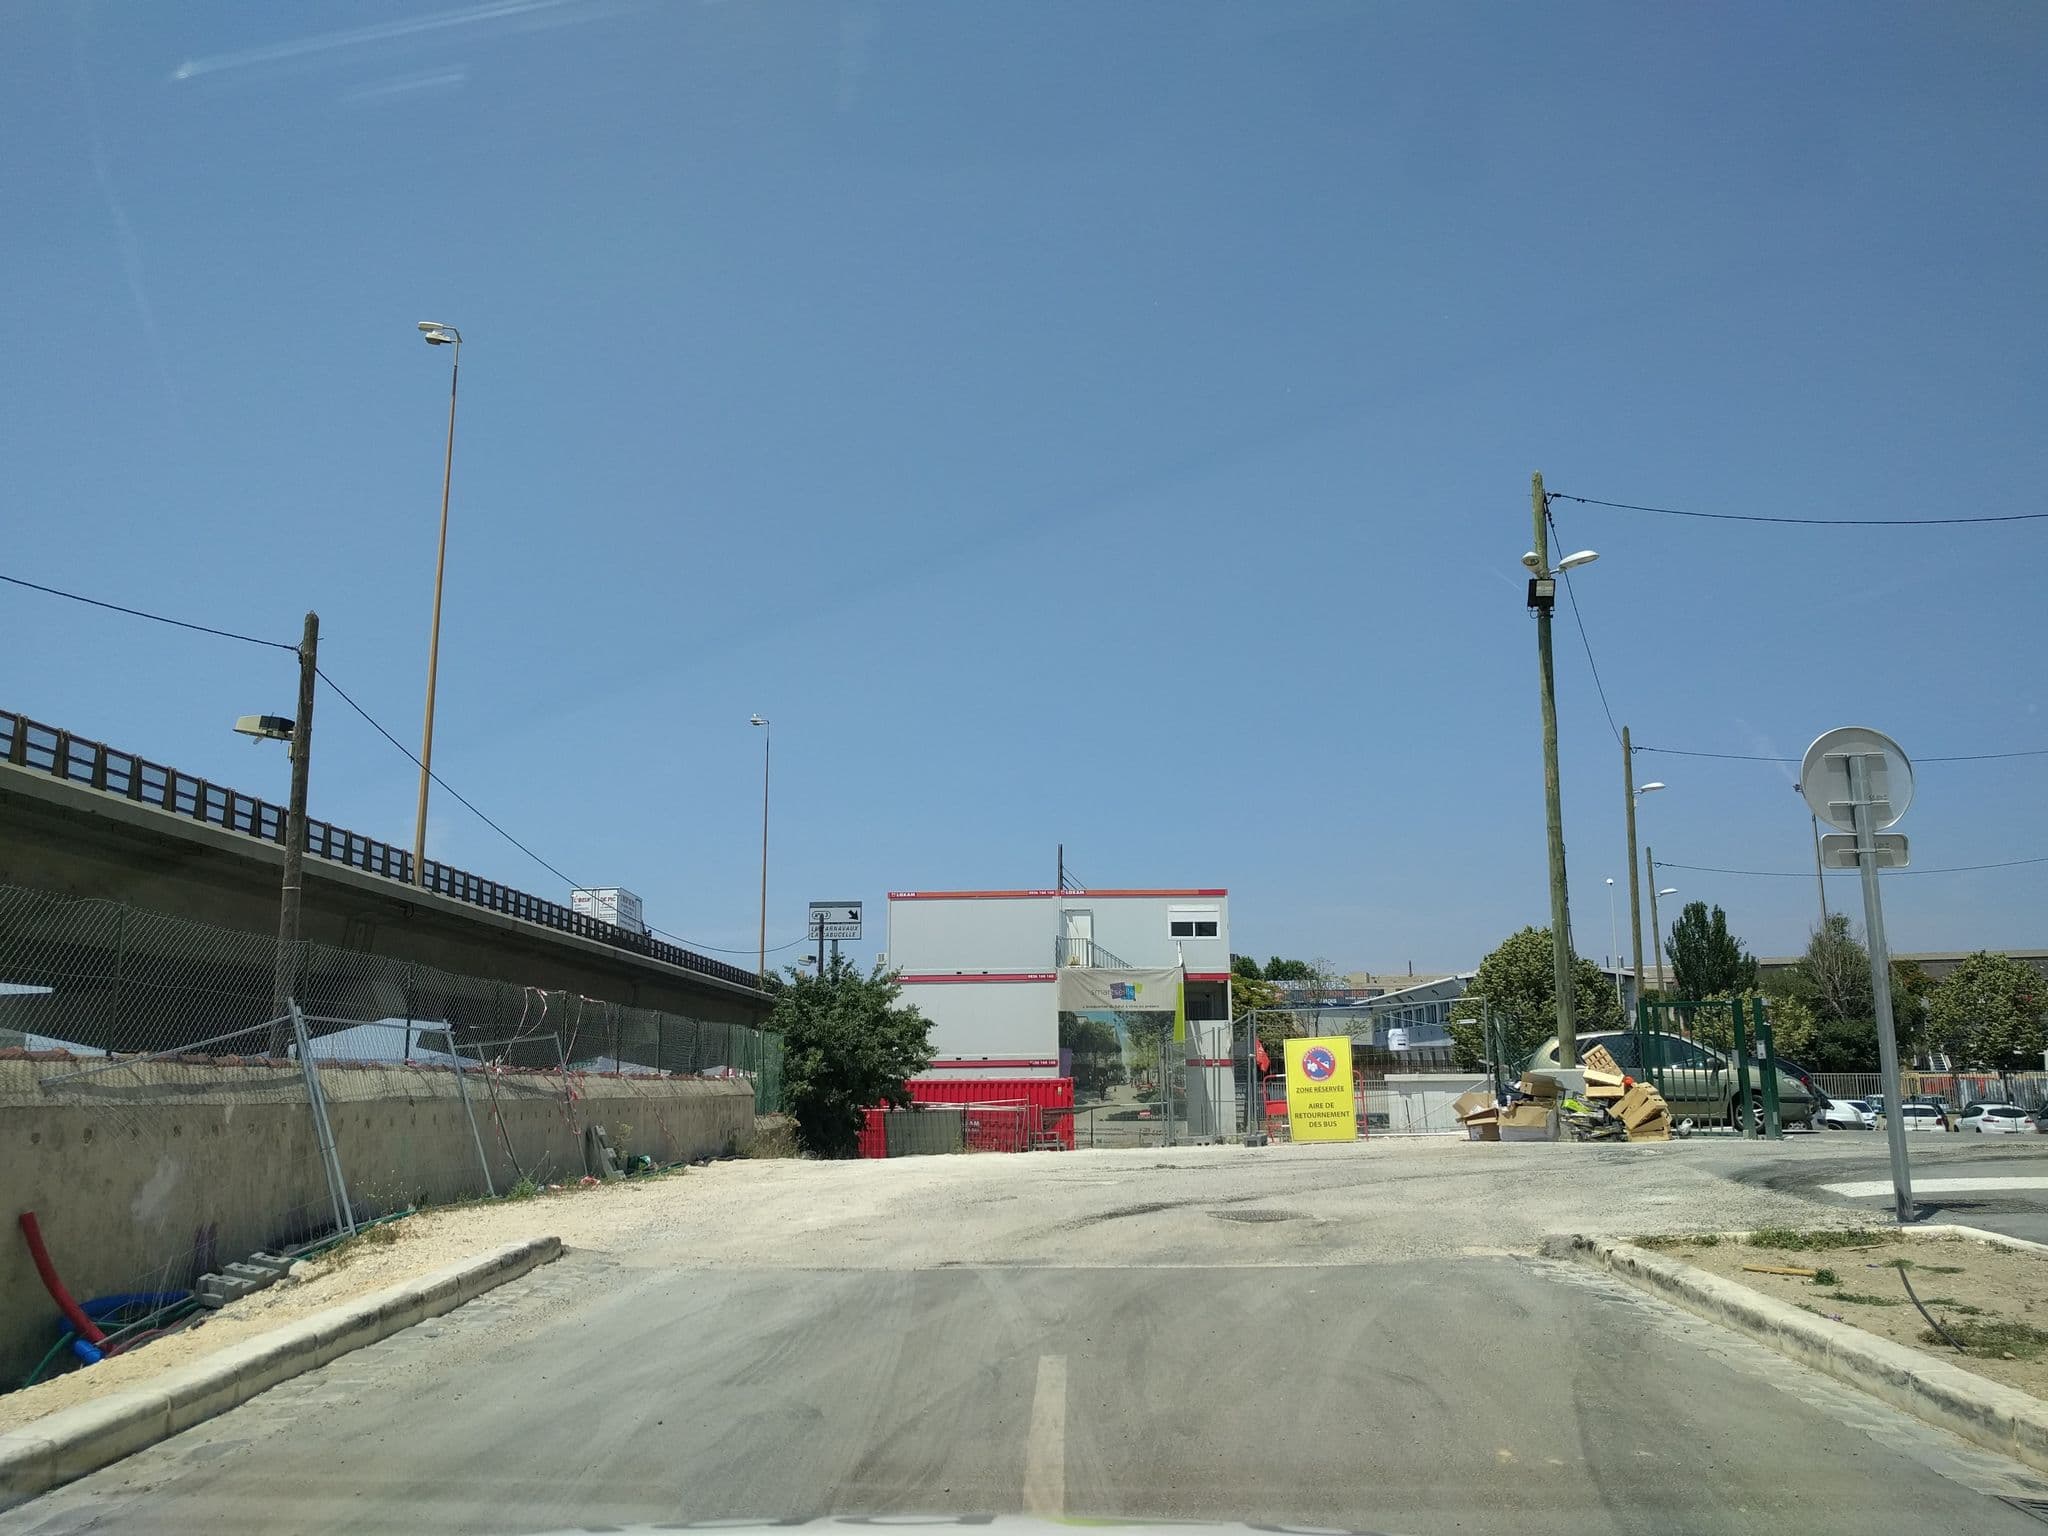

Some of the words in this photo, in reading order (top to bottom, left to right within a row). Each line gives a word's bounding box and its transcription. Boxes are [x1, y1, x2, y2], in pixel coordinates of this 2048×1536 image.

[1296, 1086, 1314, 1094] ZONE
[1314, 1085, 1345, 1093] RÉSERVÉE
[1295, 1110, 1350, 1119] RETOURNEMENT
